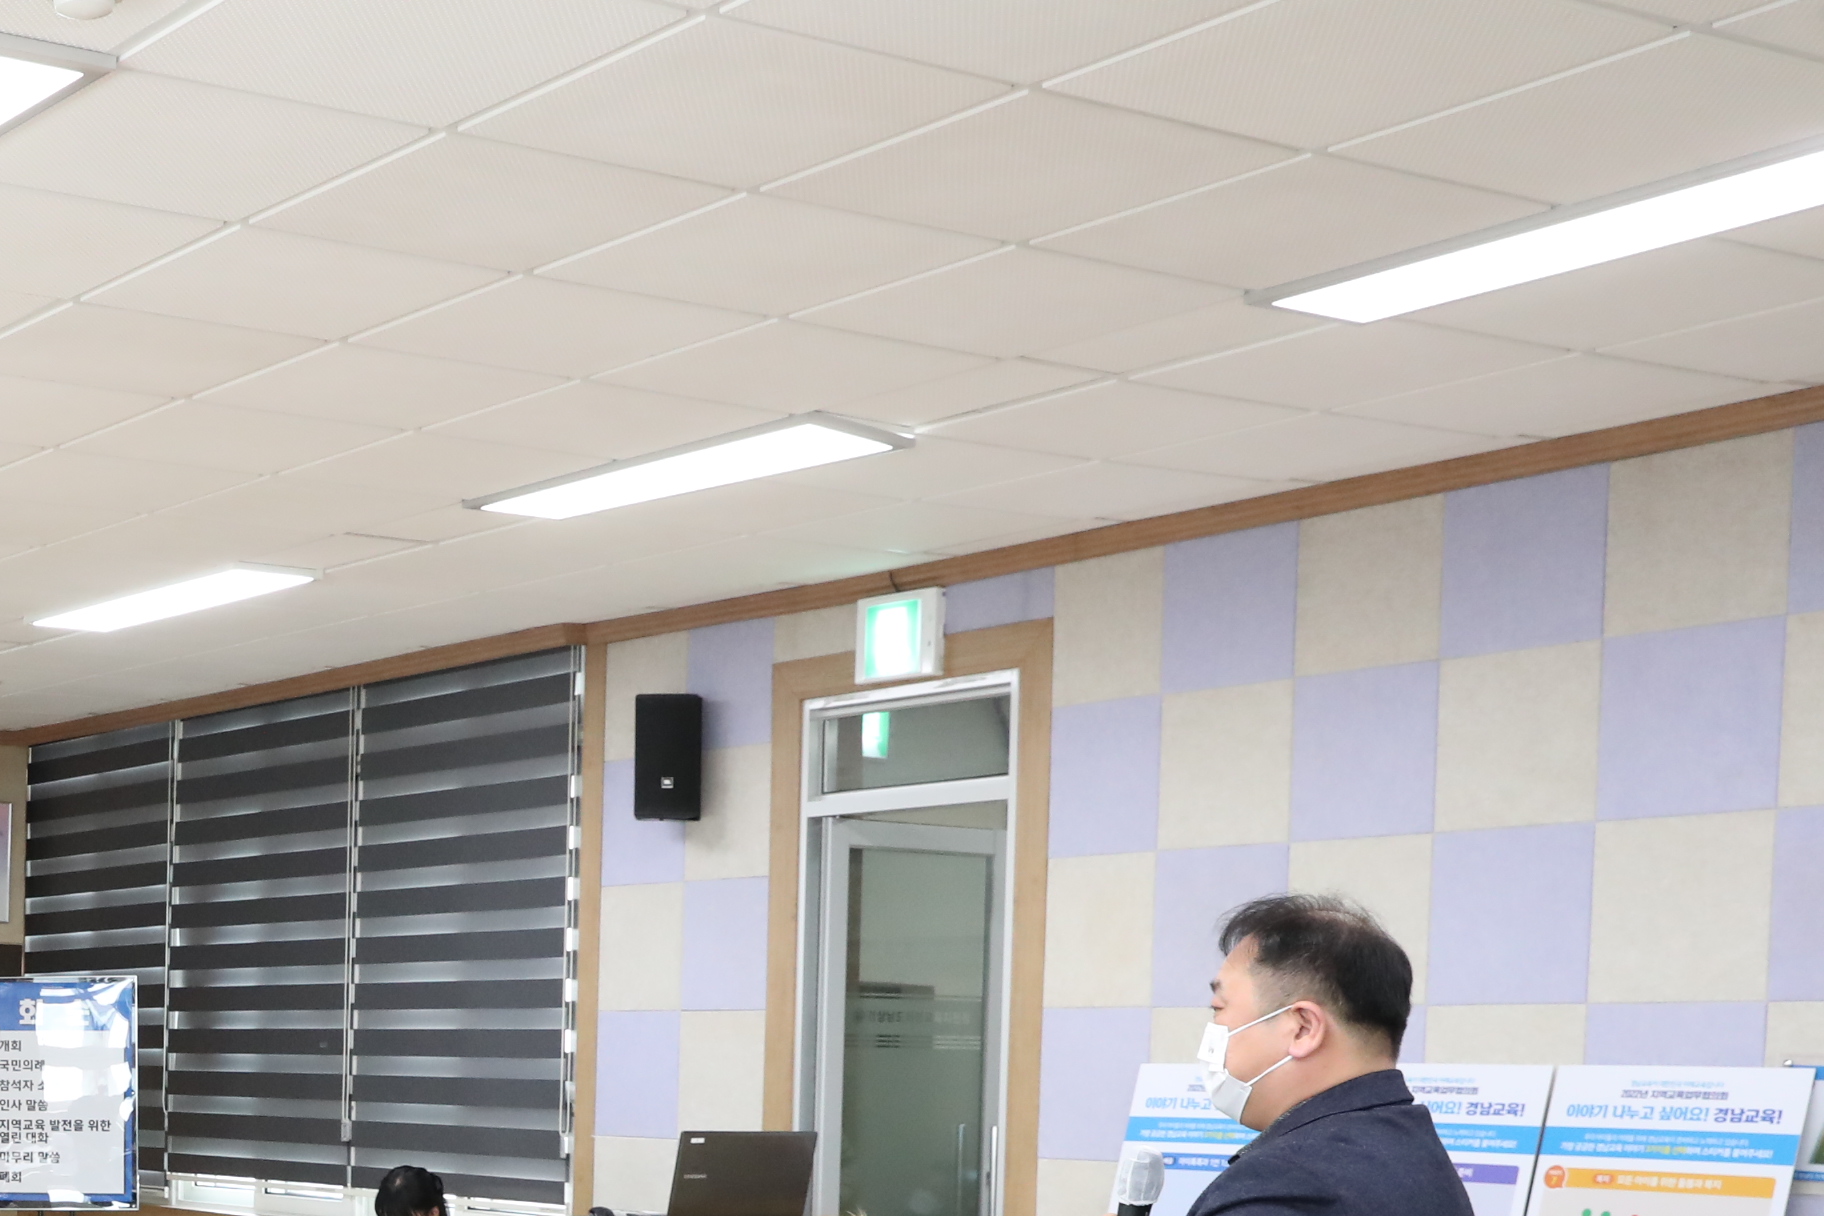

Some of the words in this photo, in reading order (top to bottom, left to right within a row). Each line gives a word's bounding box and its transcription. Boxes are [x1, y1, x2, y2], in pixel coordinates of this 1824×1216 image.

[0, 1099, 22, 1111] 인사
[25, 1099, 48, 1112] 말씀
[1145, 1097, 1177, 1109] 이야기
[1180, 1097, 1213, 1110] 나누고
[1465, 1101, 1526, 1117] 경남교육!
[1566, 1103, 1608, 1119] 이야기
[1612, 1104, 1654, 1121] 나누고
[1658, 1106, 1710, 1122] 싶어요!
[1713, 1107, 1784, 1125] 경남교육!
[0, 1119, 45, 1131] 지역교육
[49, 1119, 84, 1132] 발전을
[87, 1119, 111, 1132] 위한
[0, 1131, 22, 1144] 열린
